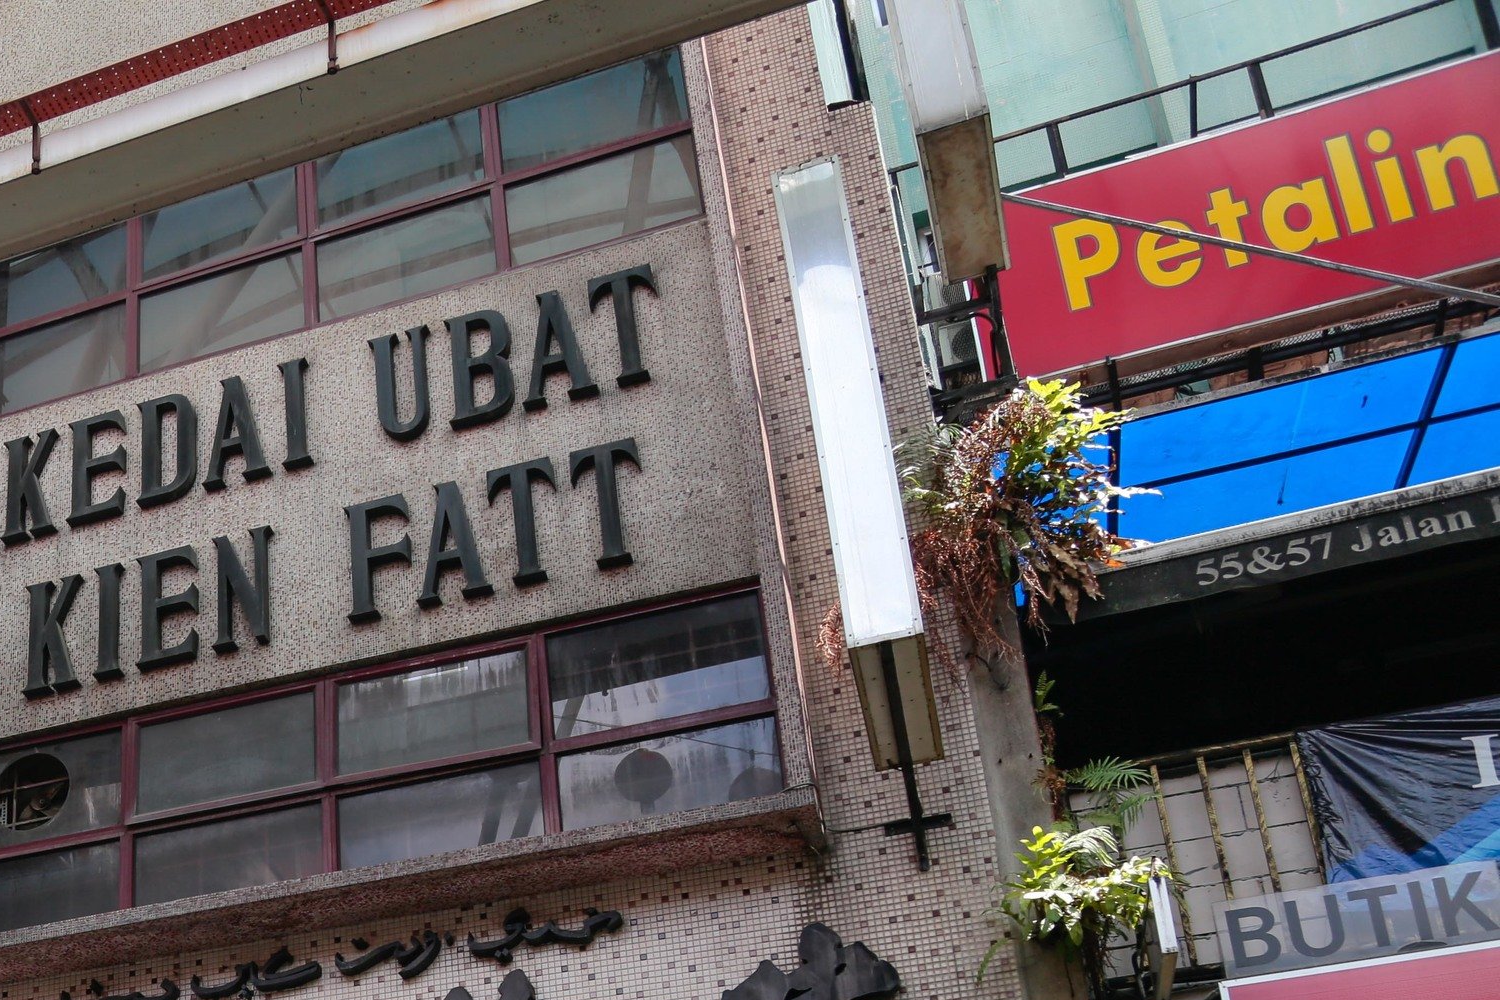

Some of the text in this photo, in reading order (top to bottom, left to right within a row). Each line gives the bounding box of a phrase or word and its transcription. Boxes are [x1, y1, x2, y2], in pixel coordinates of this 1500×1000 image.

[1051, 128, 1500, 313] Petalin
[0, 263, 659, 547] KEDAI UBAT
[23, 437, 642, 699] KIEN FATT
[1194, 531, 1333, 586] 55&57
[1350, 507, 1476, 553] Jalan
[1223, 870, 1500, 970] BUTIK
